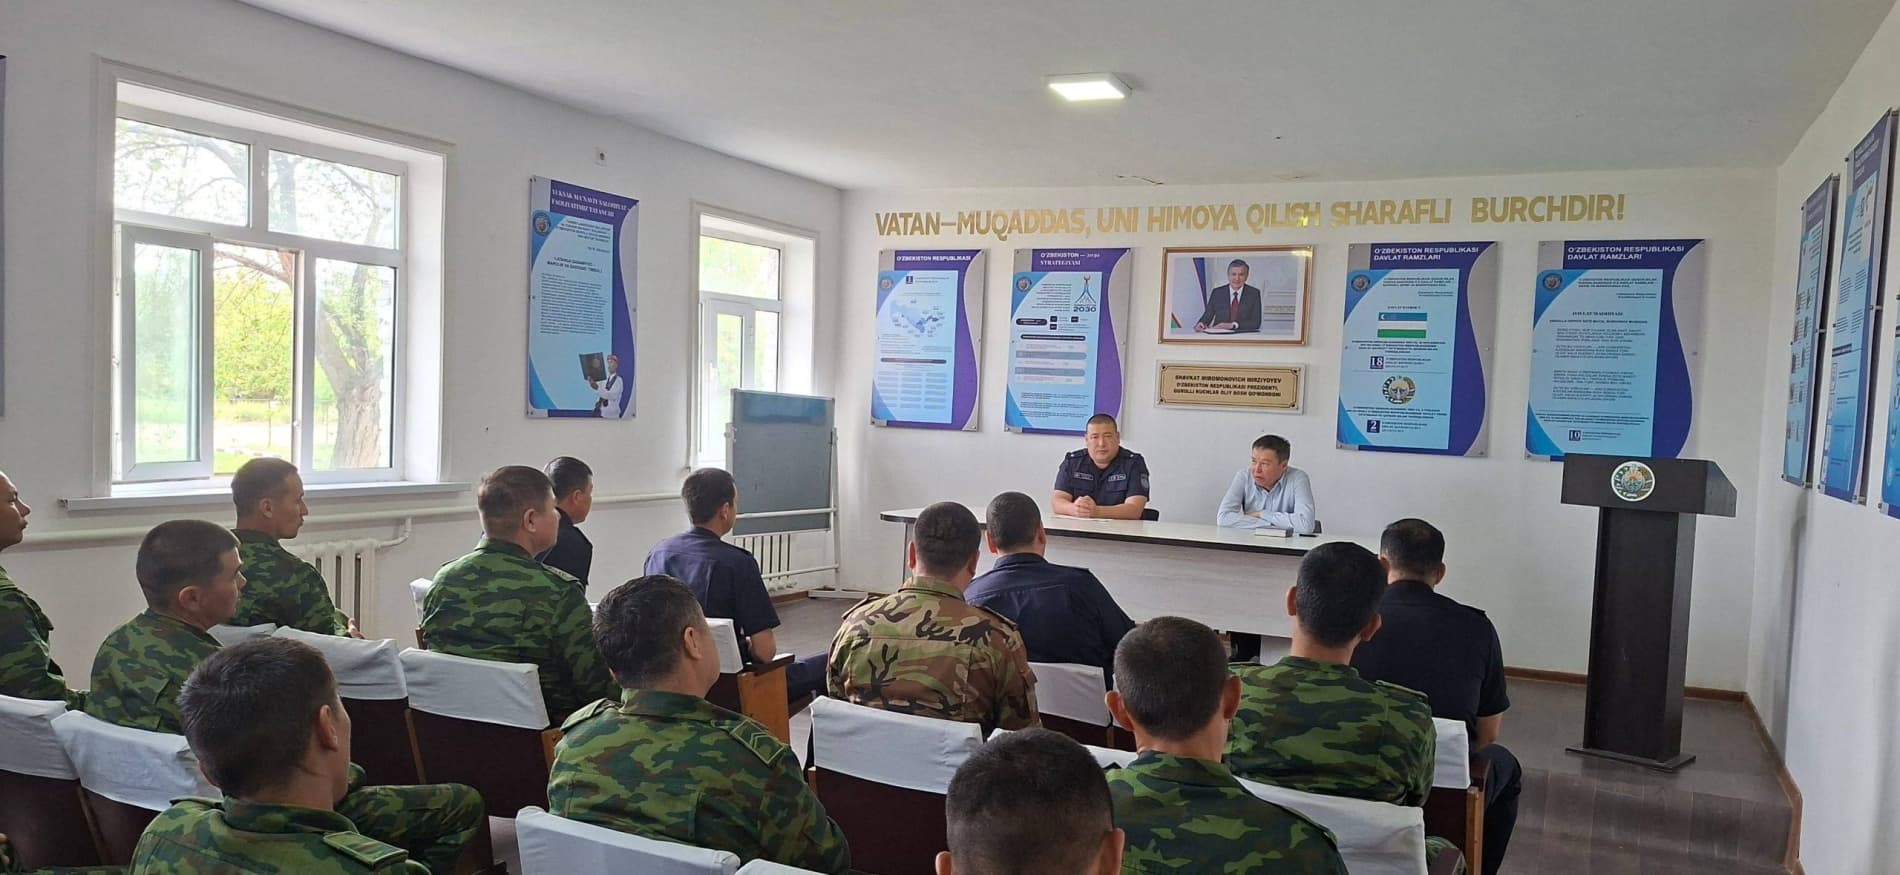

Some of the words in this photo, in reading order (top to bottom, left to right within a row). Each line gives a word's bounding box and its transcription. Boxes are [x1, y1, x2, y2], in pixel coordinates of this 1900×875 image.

[1097, 207, 1138, 233] UNI
[1147, 204, 1239, 232] HIMOYA
[1246, 202, 1320, 234] QILISH
[1330, 198, 1452, 228] SHARAFLI
[1471, 193, 1625, 223] BURCHDIR!
[1371, 357, 1383, 366] 18
[1371, 421, 1377, 430] 2
